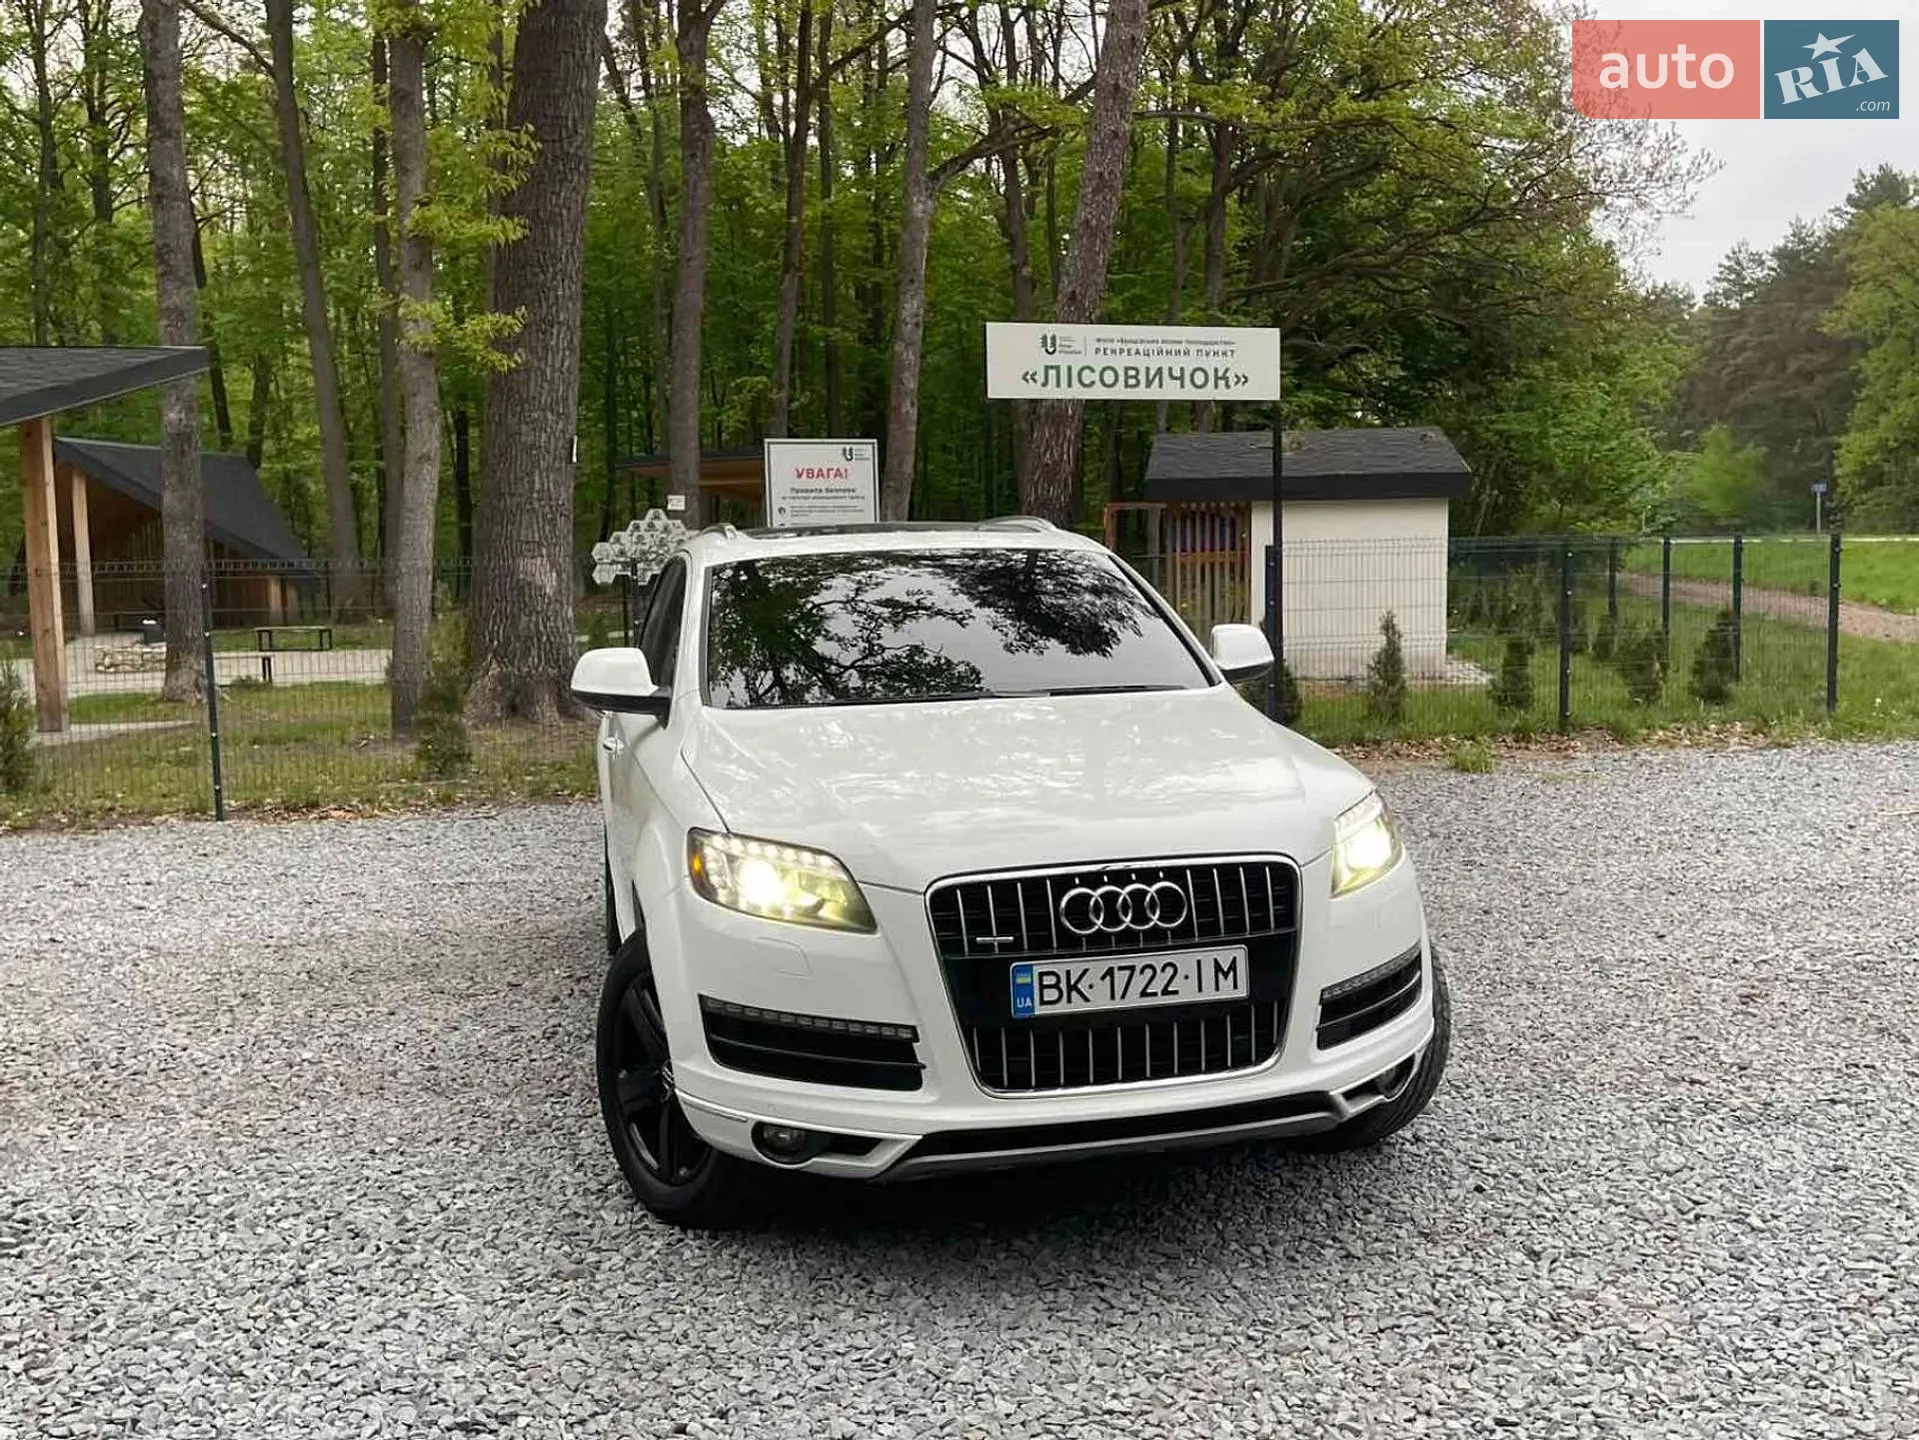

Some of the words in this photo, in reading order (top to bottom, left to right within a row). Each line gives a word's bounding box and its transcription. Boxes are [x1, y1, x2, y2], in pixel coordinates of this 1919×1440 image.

[1094, 346, 1190, 357] РЕКРЕАЦІЙНИЙ
[1196, 349, 1236, 358] ПУНКТ
[1021, 364, 1249, 390] «ЛІСОВИЧОК»
[794, 467, 849, 479] УВАГА!
[1017, 999, 1033, 1009] UA
